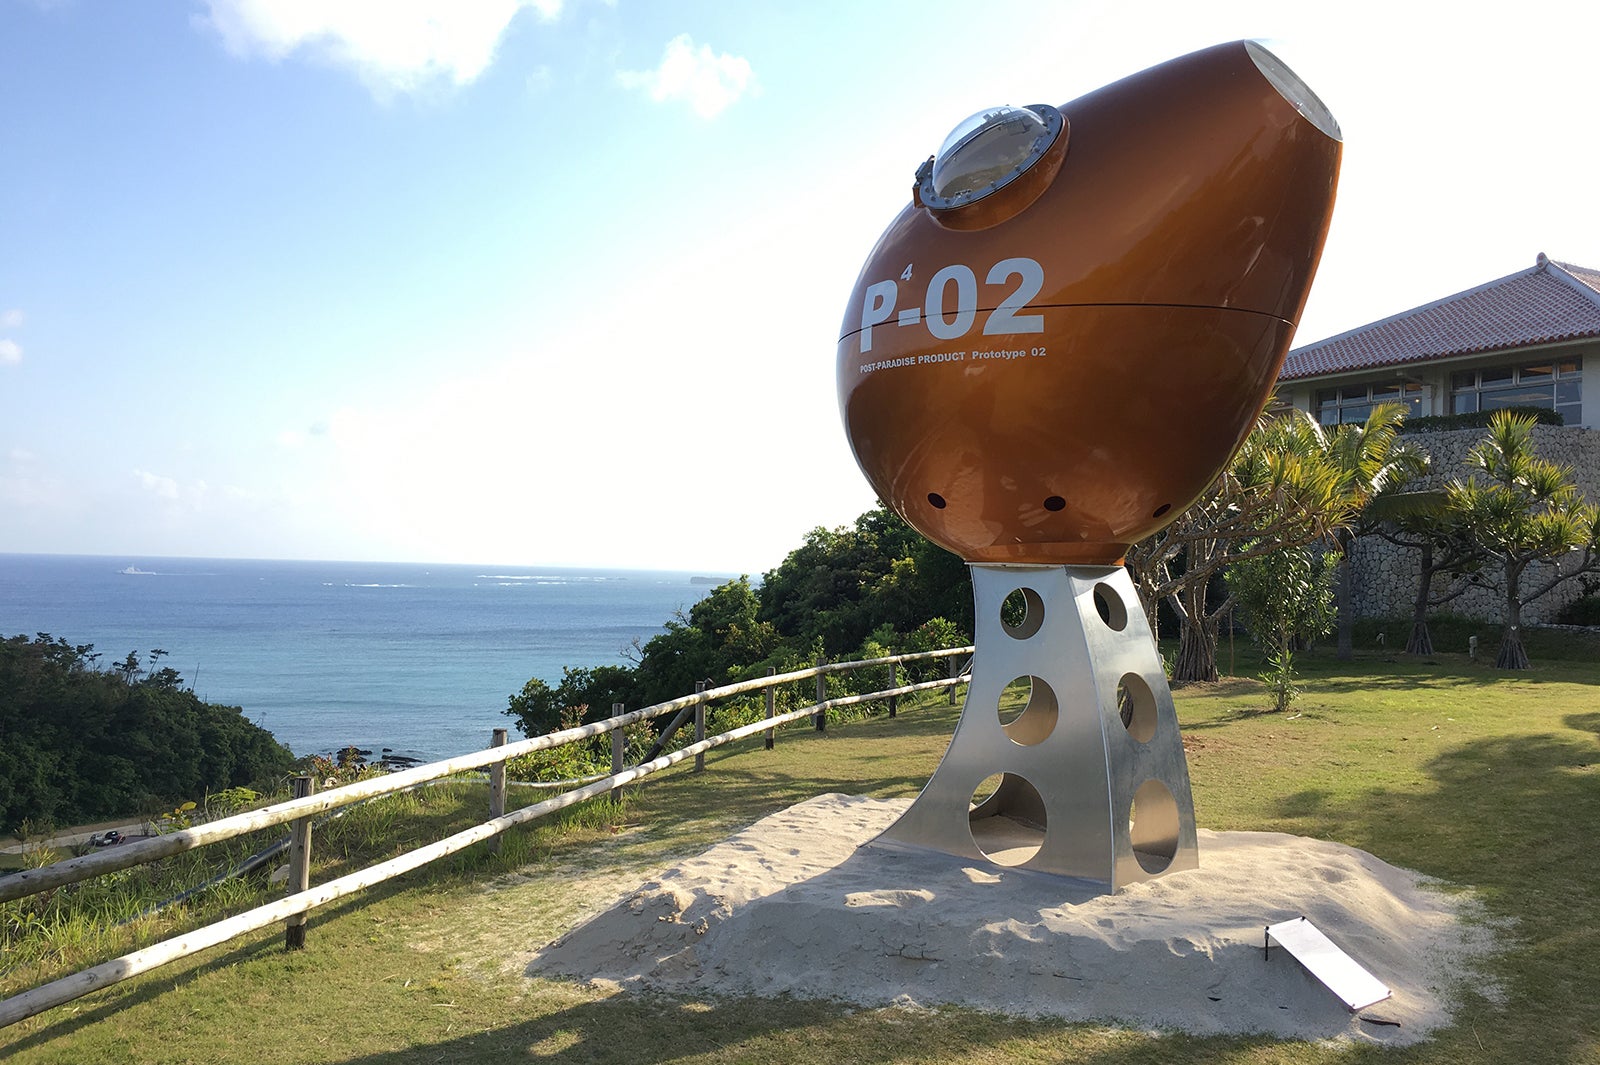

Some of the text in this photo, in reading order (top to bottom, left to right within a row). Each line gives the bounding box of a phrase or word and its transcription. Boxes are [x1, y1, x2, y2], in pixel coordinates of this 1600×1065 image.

[860, 347, 1047, 374] POST-PARADISE PRODUCT Prototype 02
